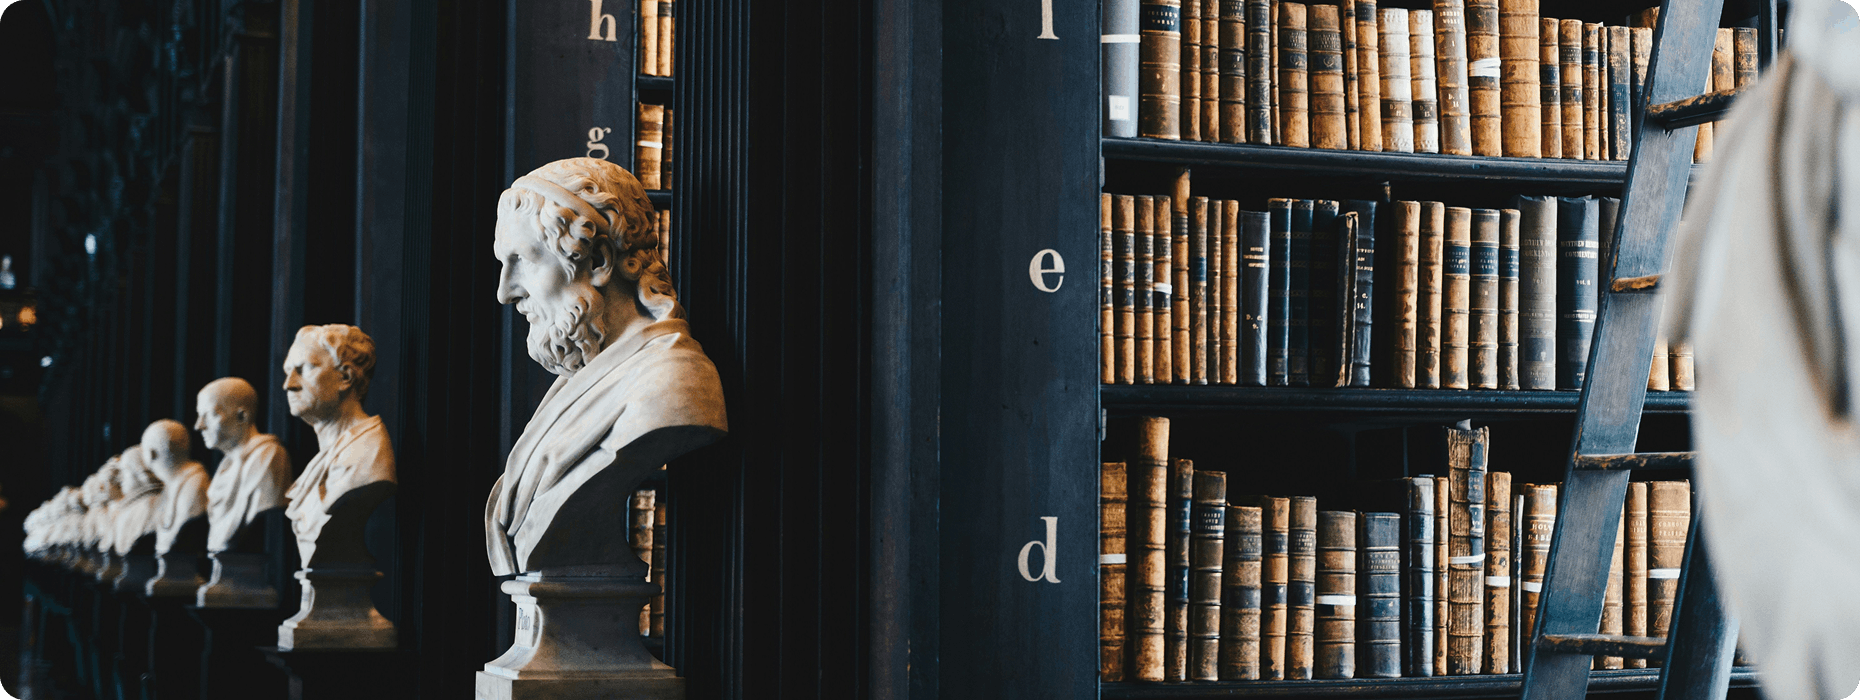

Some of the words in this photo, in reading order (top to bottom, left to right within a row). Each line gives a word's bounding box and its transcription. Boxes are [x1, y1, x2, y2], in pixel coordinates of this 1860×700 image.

[586, 0, 617, 42] h
[586, 127, 612, 160] g
[1028, 248, 1066, 293] e
[1017, 516, 1061, 583] d
